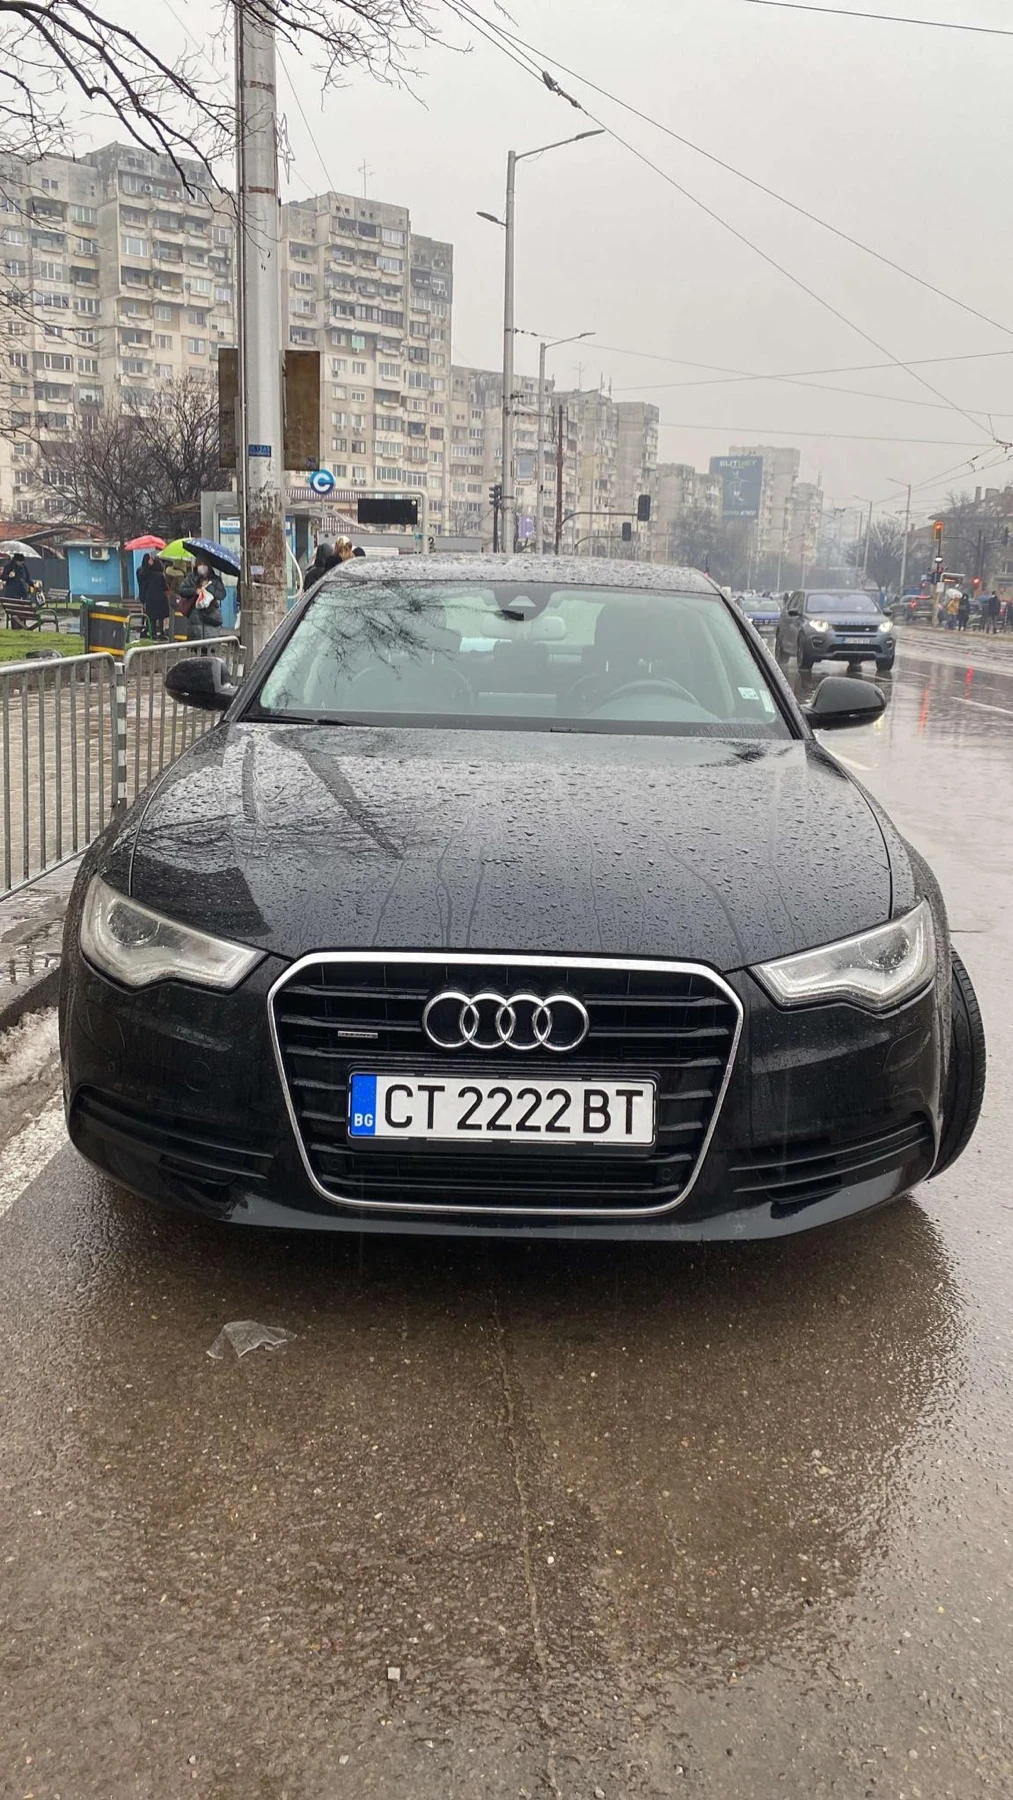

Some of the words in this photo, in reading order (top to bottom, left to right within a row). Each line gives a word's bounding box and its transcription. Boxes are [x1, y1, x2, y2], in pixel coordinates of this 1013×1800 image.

[354, 1112, 374, 1127] BG
[385, 1083, 445, 1130] CT
[457, 1086, 573, 1134] 2222
[583, 1089, 644, 1135] BT
